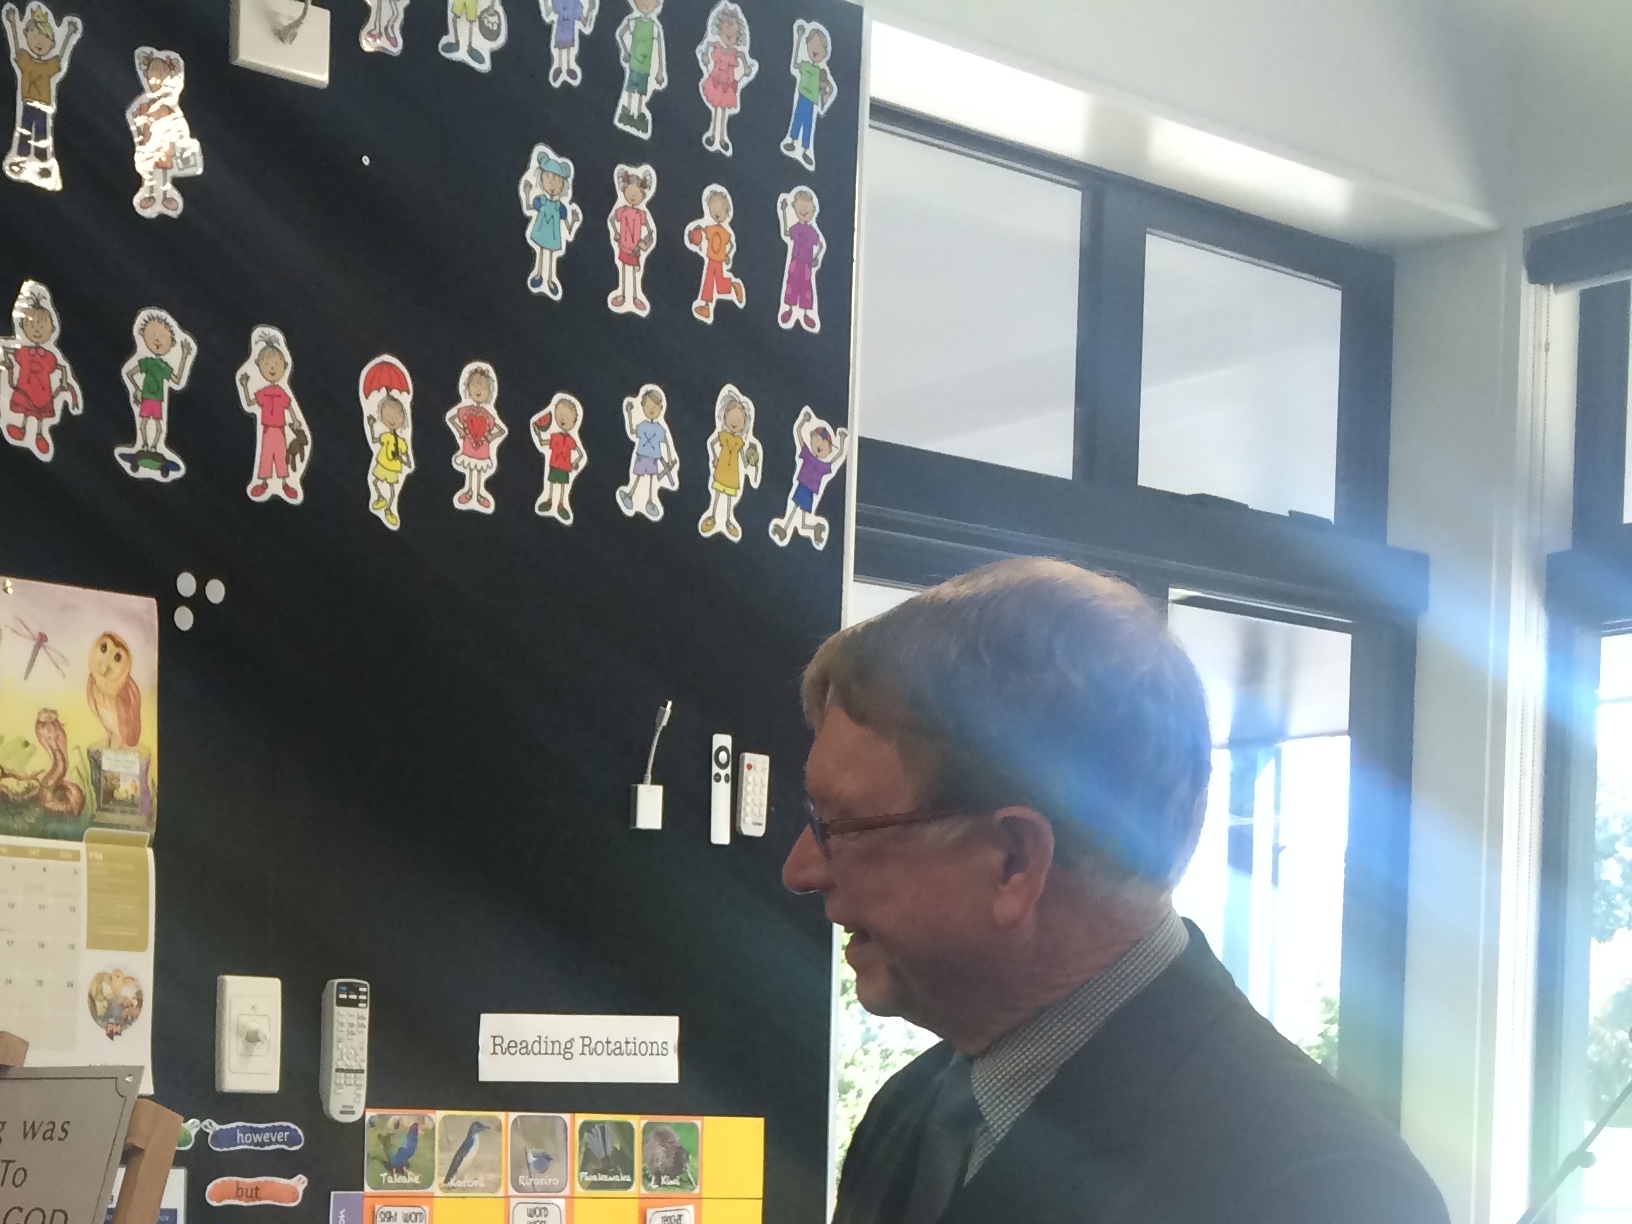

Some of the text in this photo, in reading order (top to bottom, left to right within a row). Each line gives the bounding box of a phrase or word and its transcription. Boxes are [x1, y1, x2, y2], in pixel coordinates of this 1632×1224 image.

[28, 74, 44, 94] K
[541, 213, 556, 236] M
[623, 216, 637, 243] N
[29, 360, 45, 385] R
[148, 366, 163, 397] S
[262, 393, 283, 416] T
[643, 430, 658, 449] X
[89, 851, 103, 861] PM
[107, 1023, 122, 1035] PM
[490, 1034, 670, 1061] Reading Rotations
[22, 1118, 71, 1143] was
[236, 1128, 290, 1144] however
[0, 1158, 29, 1189] To
[518, 1174, 561, 1187] Riroriro
[660, 1174, 681, 1187] Kiwi
[235, 1181, 261, 1200] but
